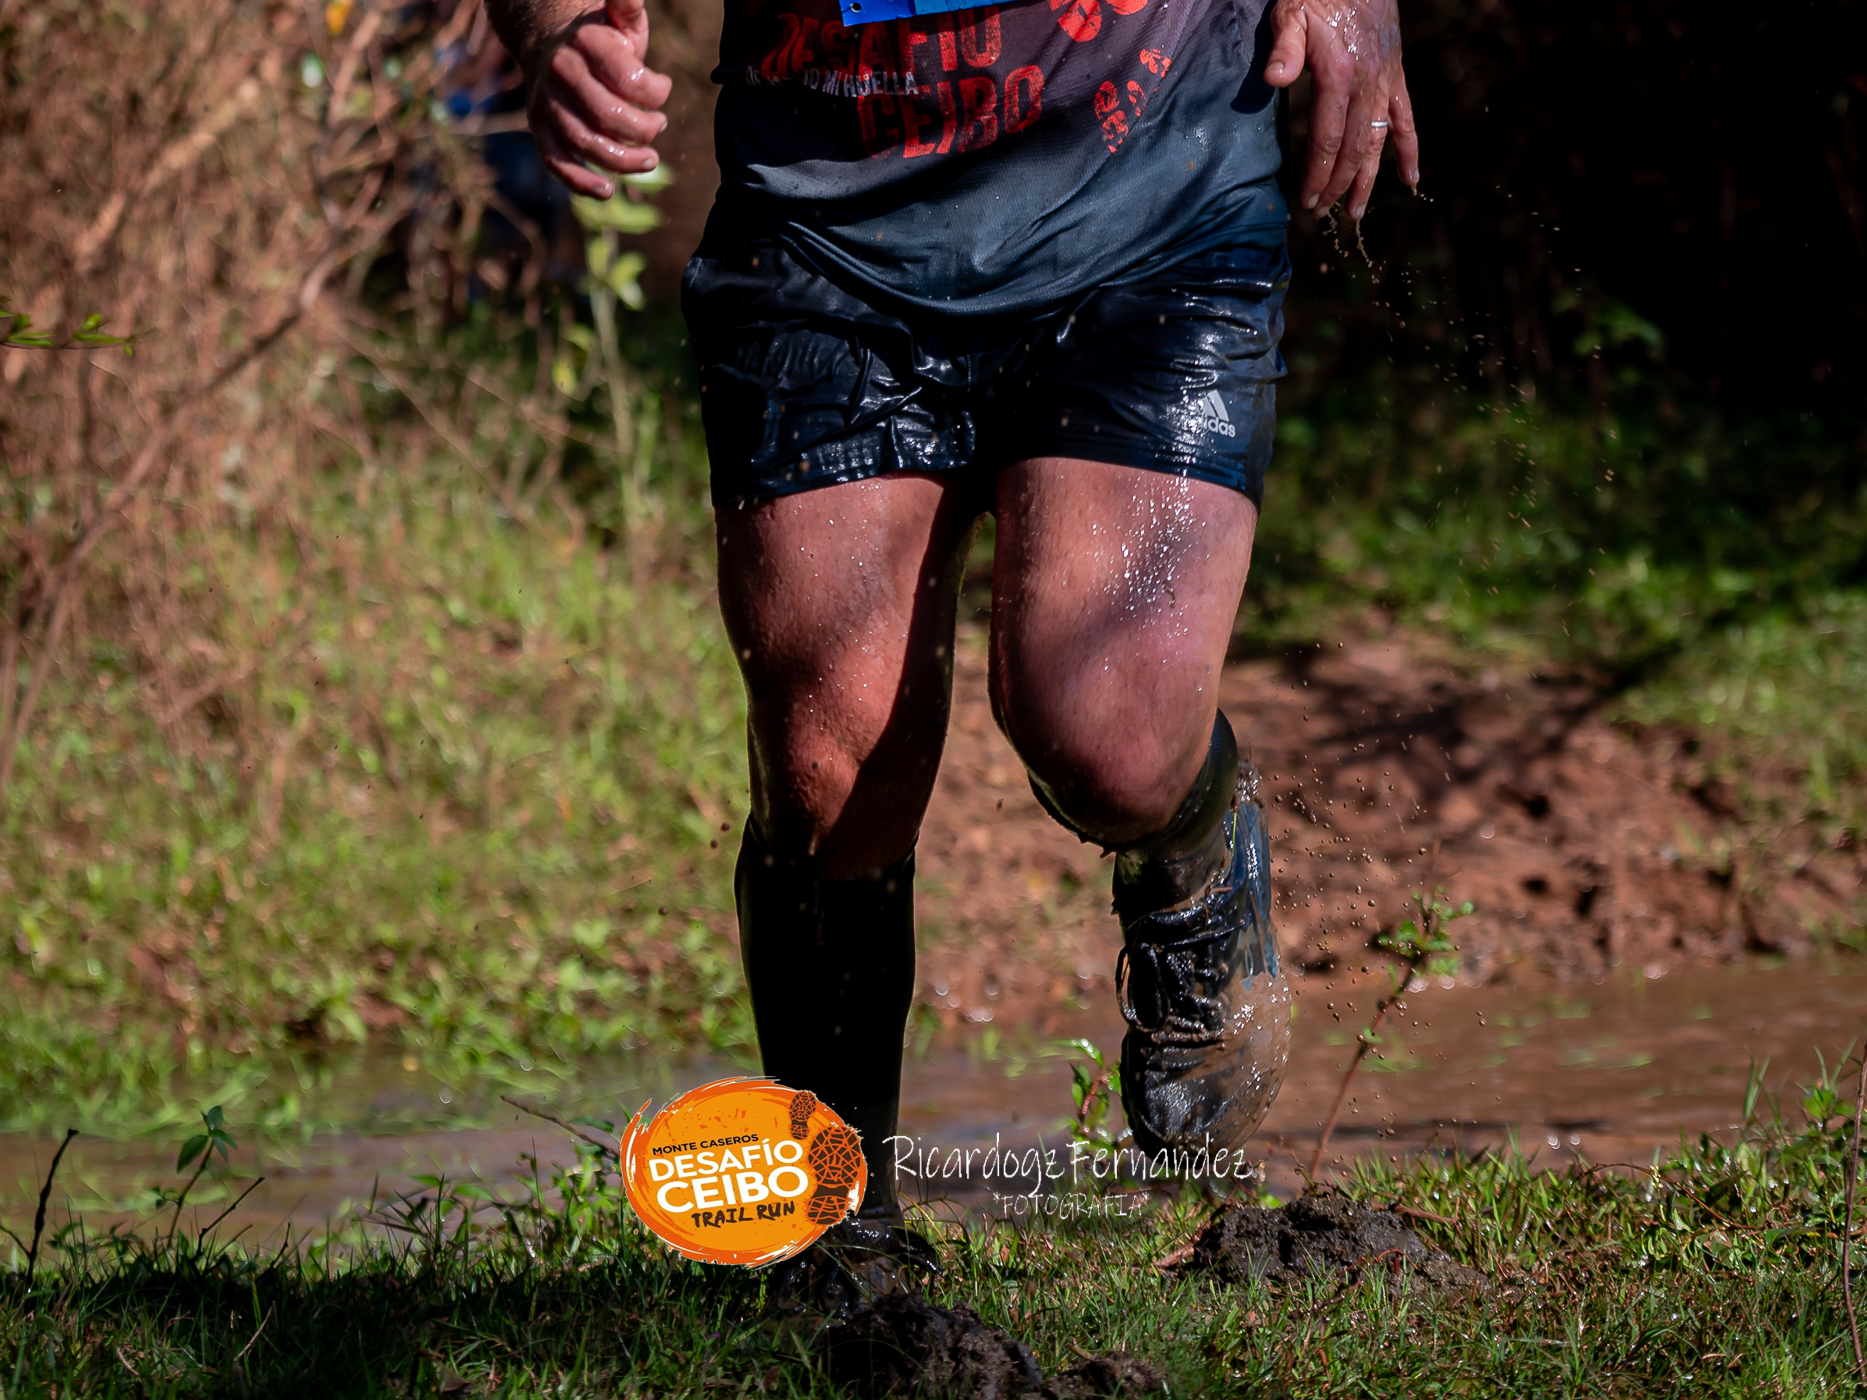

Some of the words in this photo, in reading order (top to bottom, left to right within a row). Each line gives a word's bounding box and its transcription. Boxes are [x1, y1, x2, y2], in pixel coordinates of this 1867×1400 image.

[761, 4, 1001, 80] DESAFIO
[843, 71, 919, 98] HUELLA
[857, 64, 1045, 159] CEIBO
